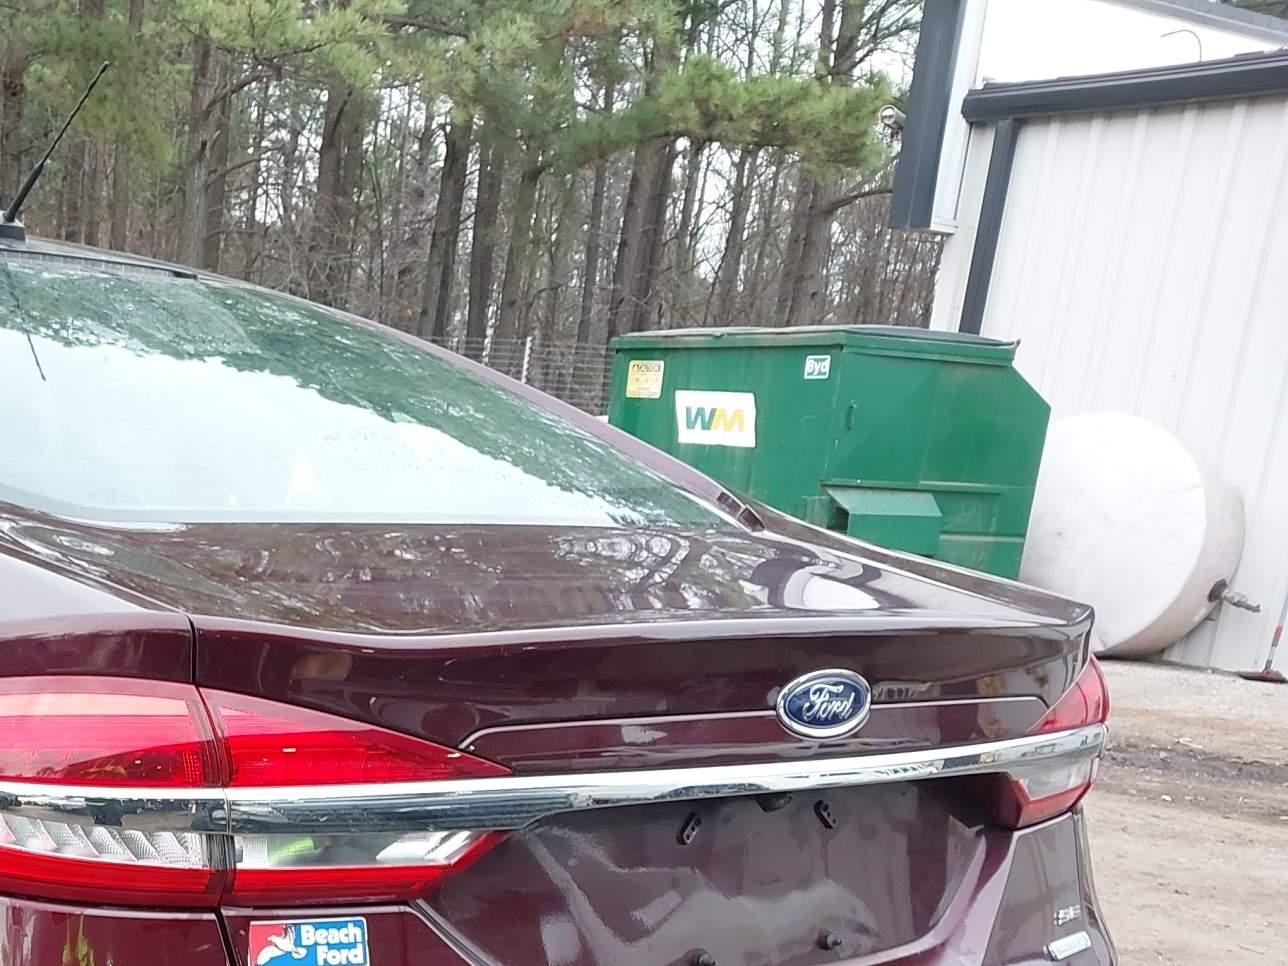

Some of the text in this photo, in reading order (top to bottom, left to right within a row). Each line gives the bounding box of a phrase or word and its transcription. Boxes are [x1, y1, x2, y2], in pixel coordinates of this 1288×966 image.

[685, 406, 745, 432] WM
[803, 683, 856, 721] Ford
[301, 922, 362, 946] Beach
[316, 943, 364, 966] Ford
